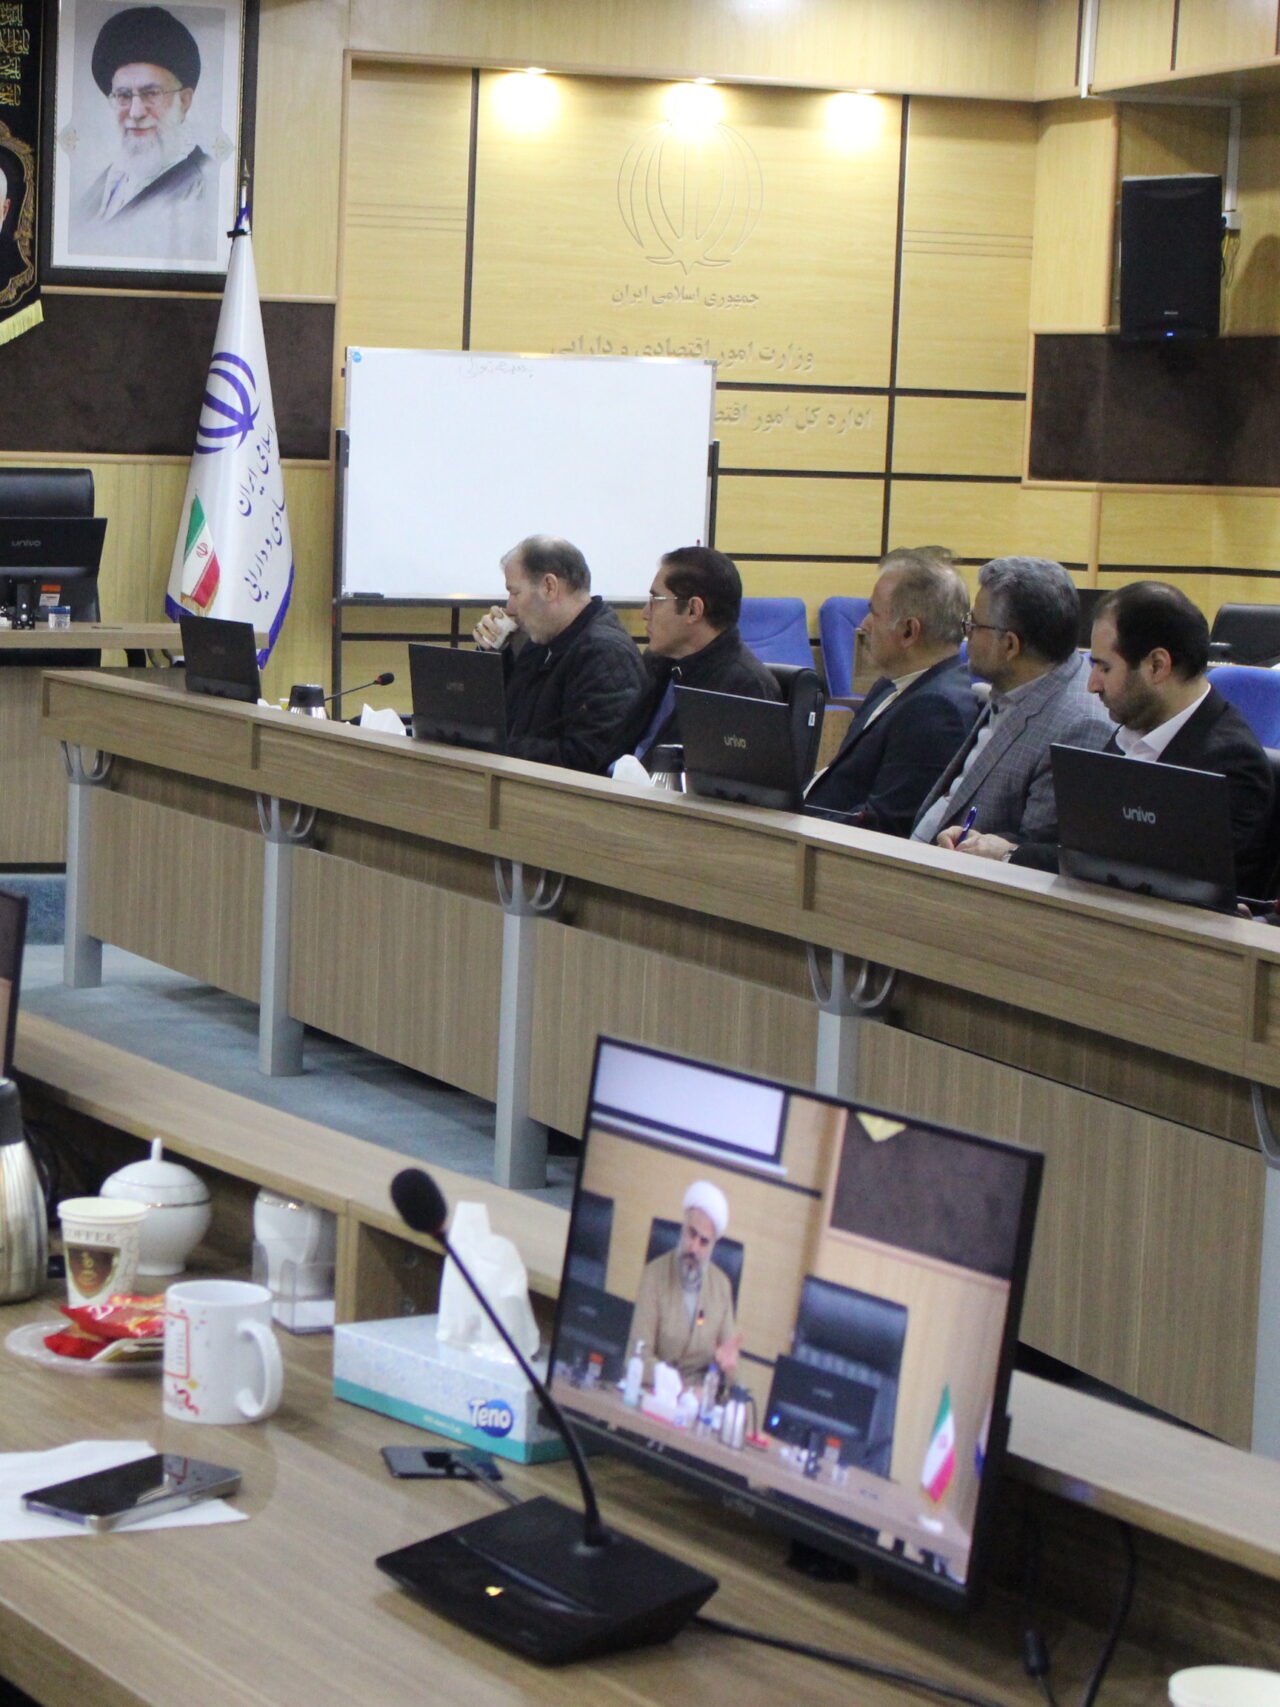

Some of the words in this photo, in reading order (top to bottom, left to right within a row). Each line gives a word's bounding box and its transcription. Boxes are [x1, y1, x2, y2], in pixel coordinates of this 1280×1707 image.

[611, 284, 648, 304] ایران
[651, 286, 700, 305] اسلامی
[704, 290, 760, 309] جمهوری
[759, 343, 814, 372] وزارت
[753, 406, 790, 433] امور
[796, 405, 821, 431] کل
[827, 407, 872, 434] اداره
[237, 466, 265, 517] ایران
[1122, 805, 1157, 825] univo
[468, 1397, 512, 1429] Teno
